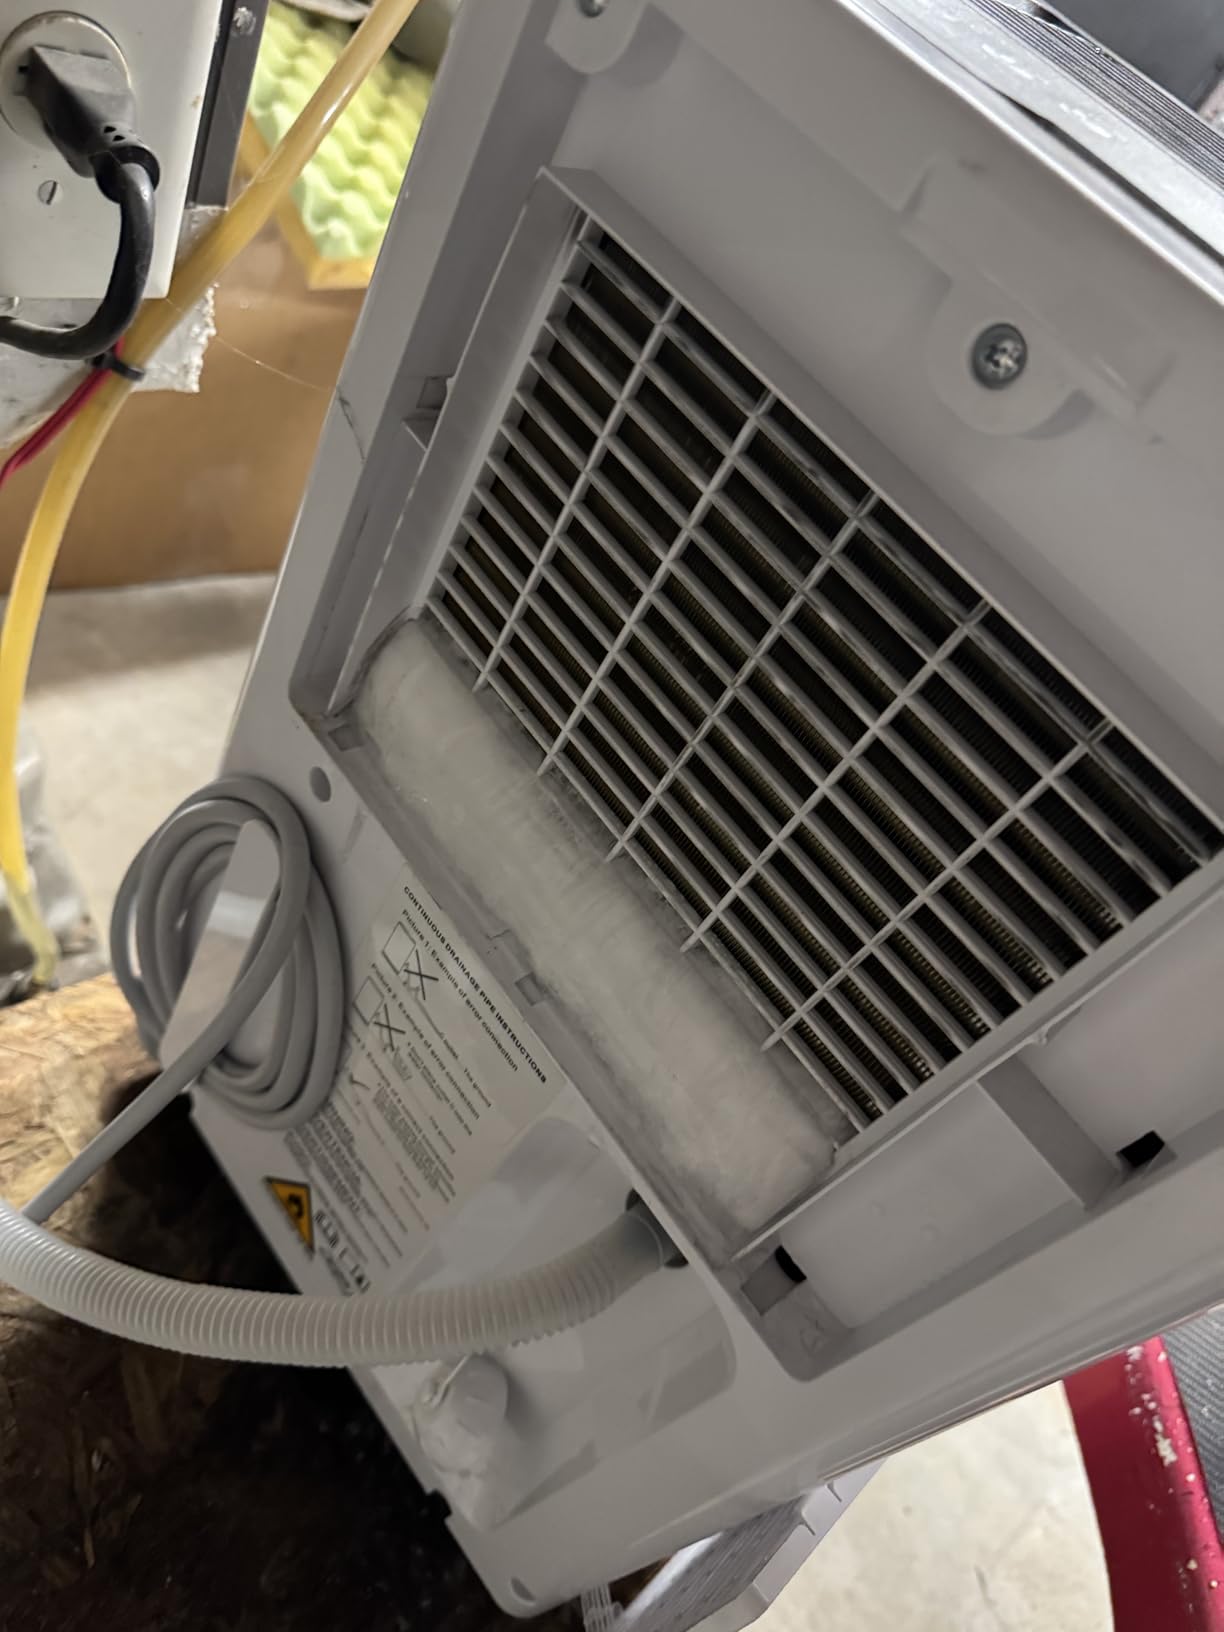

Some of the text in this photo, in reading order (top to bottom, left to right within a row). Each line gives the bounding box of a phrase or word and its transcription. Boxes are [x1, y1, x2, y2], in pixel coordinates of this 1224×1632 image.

[400, 908, 426, 941] Picture
[428, 948, 460, 989] Example
[456, 987, 467, 999] of
[463, 997, 483, 1021] error
[479, 1020, 519, 1072] connection
[402, 884, 548, 1084] CONTINUOUS DRAINAGE PIPE INSTRUCTIONS
